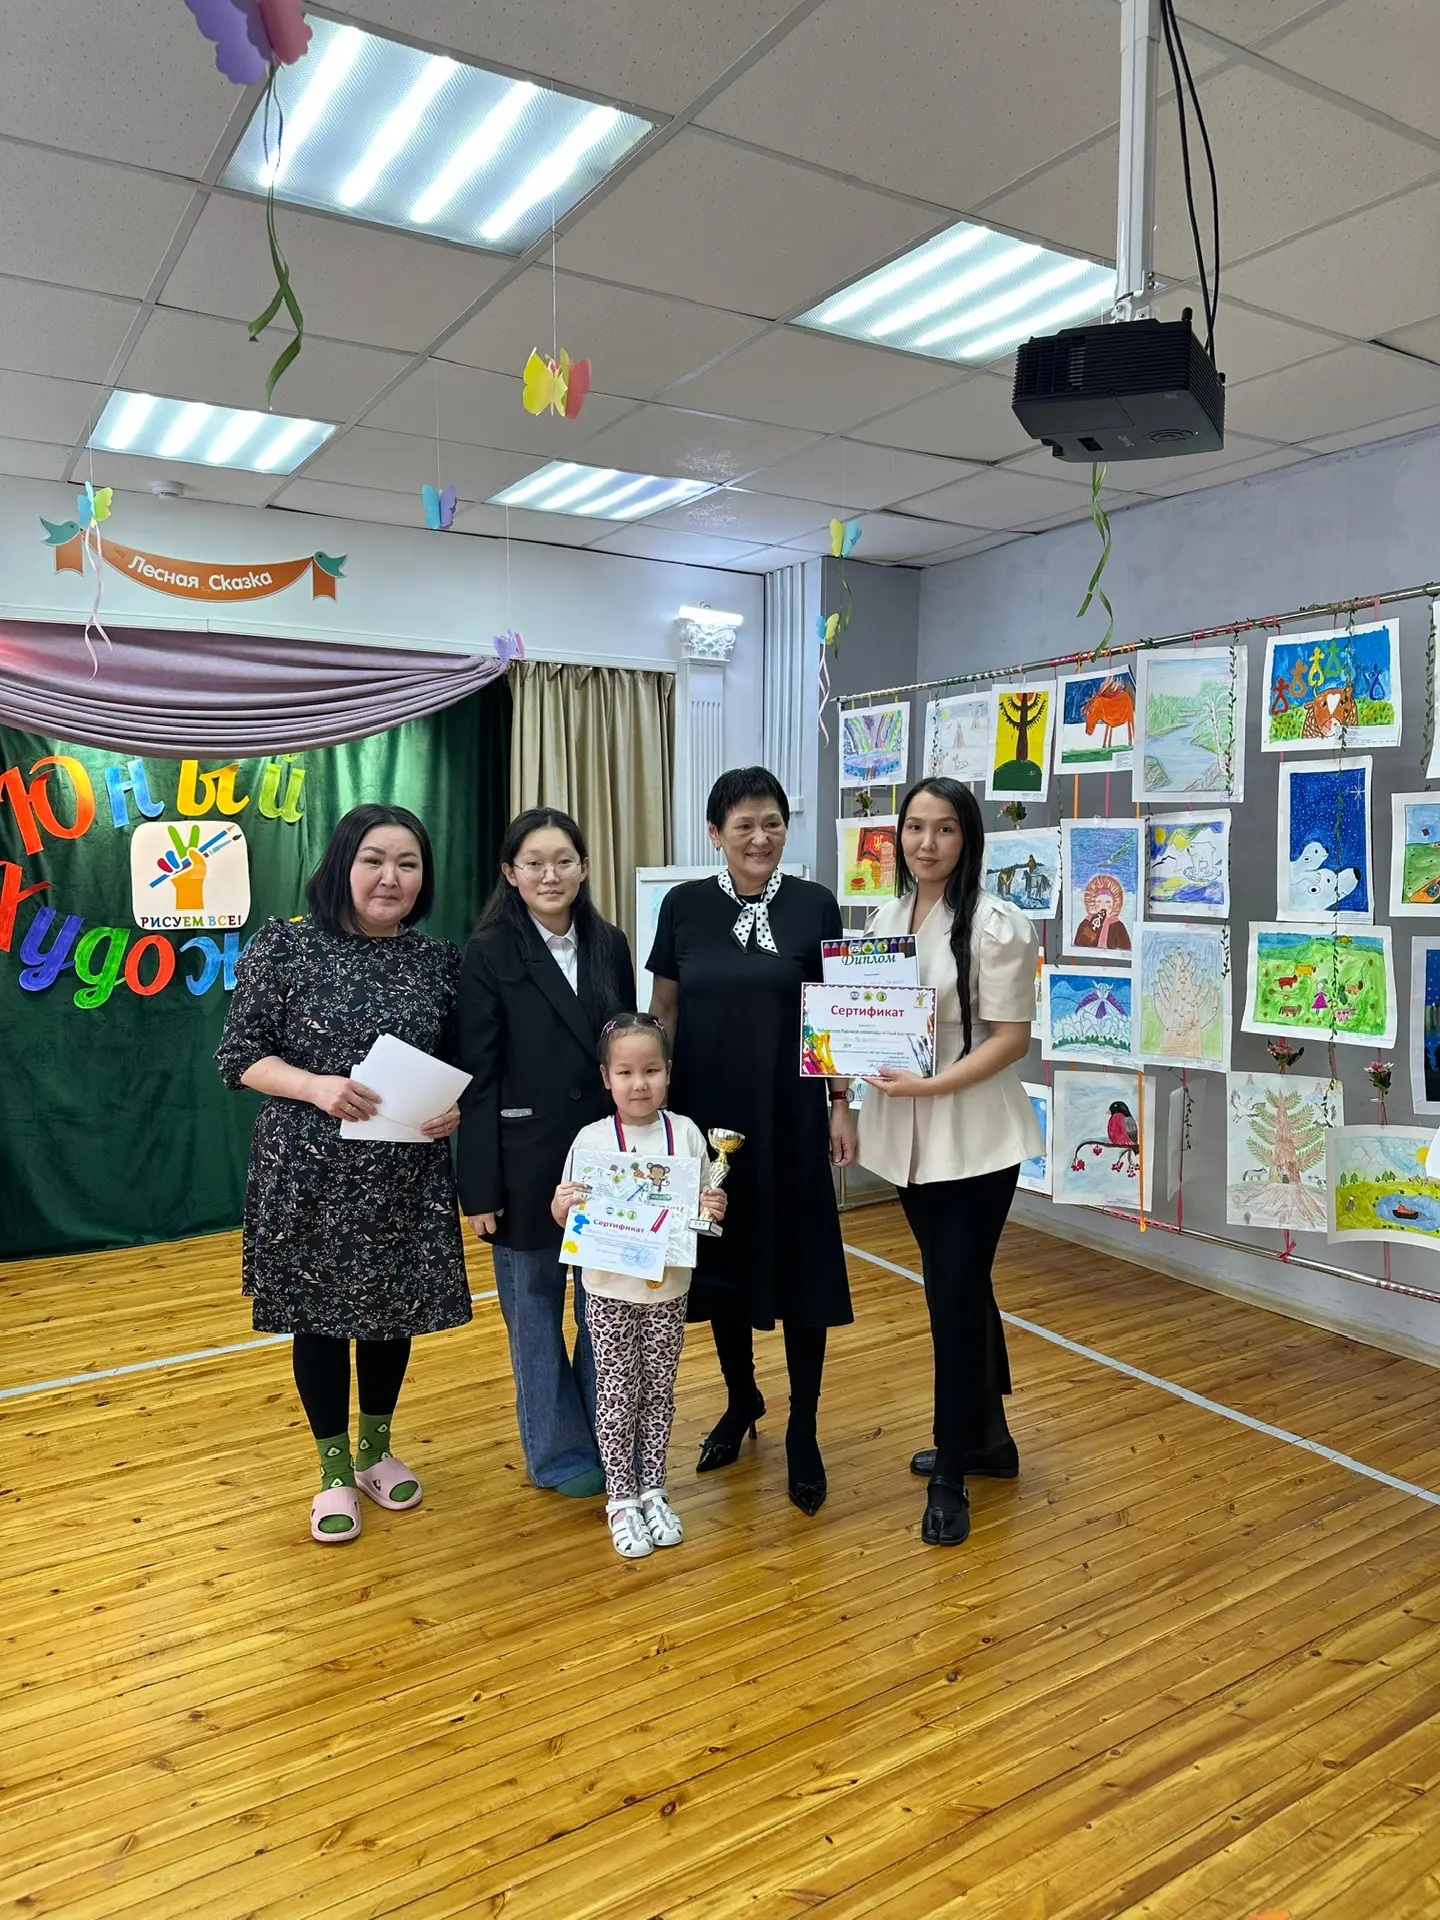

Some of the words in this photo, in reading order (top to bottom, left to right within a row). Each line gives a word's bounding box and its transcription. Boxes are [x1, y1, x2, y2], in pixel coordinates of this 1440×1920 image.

[128, 555, 200, 589] Лесная
[208, 571, 273, 591] Сказка
[140, 916, 205, 929] РИСУЕМ
[208, 914, 242, 927] ВСЕ!
[841, 952, 897, 966] Диплом
[830, 1004, 905, 1019] Сертификат
[592, 1218, 645, 1234] Сертификат
